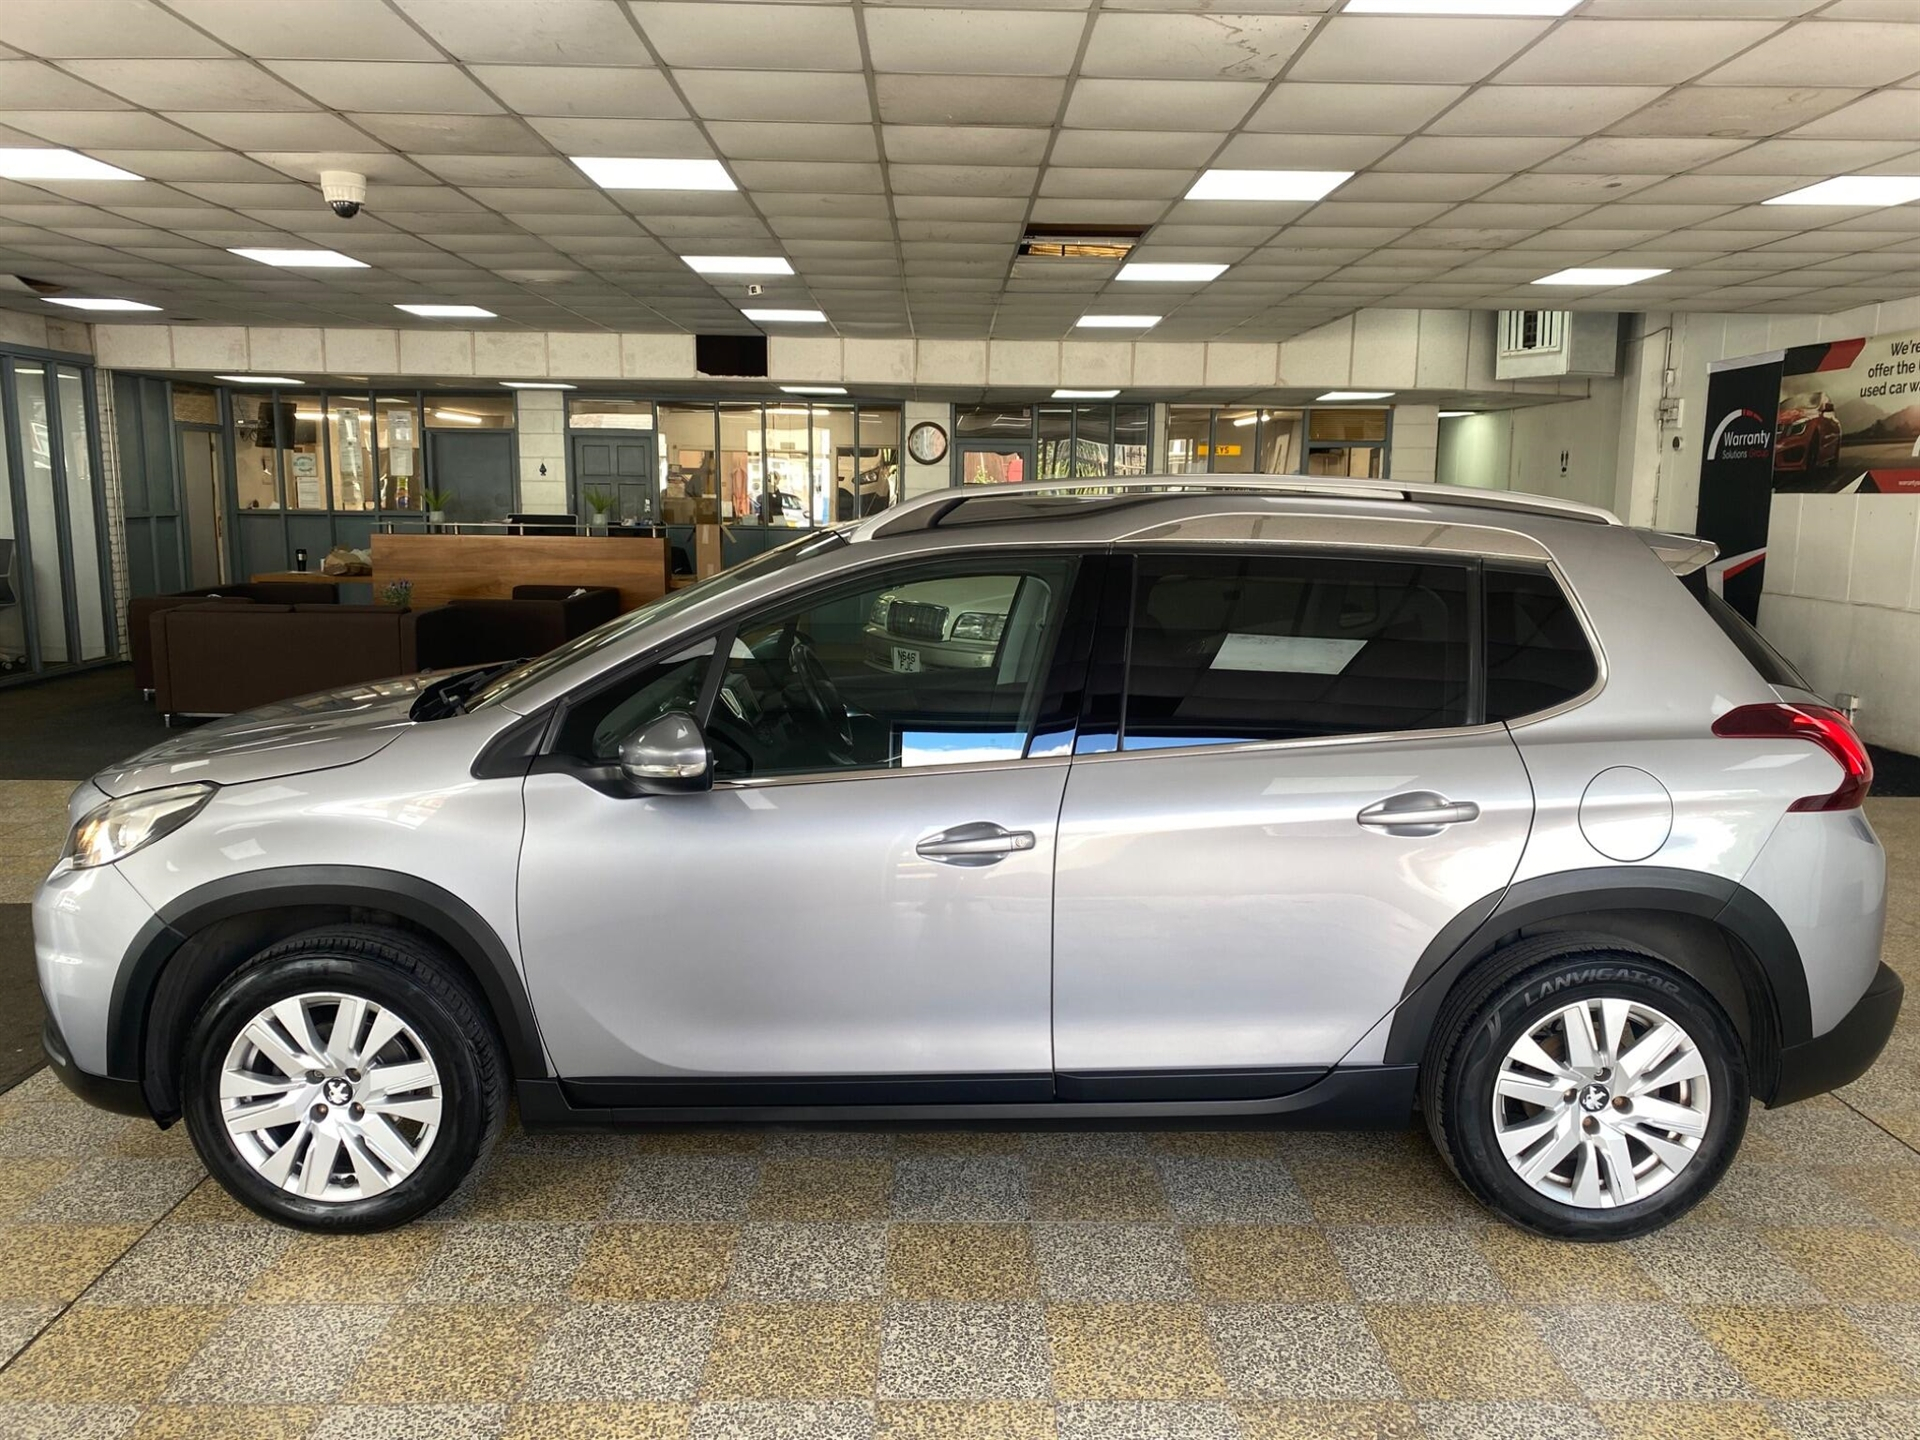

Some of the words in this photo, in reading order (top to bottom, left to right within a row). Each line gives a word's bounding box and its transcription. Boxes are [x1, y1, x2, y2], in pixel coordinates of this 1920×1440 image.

[1891, 339, 1920, 356] We're
[1868, 363, 1895, 378] offer
[1897, 360, 1916, 375] the
[1860, 381, 1887, 398] used
[1889, 382, 1908, 395] car
[1724, 430, 1770, 448] Warranty
[1215, 446, 1230, 454] EYS
[1722, 449, 1748, 459] Solutions
[1748, 449, 1769, 459] Group
[1523, 967, 1681, 1007] LANVIGATOR
